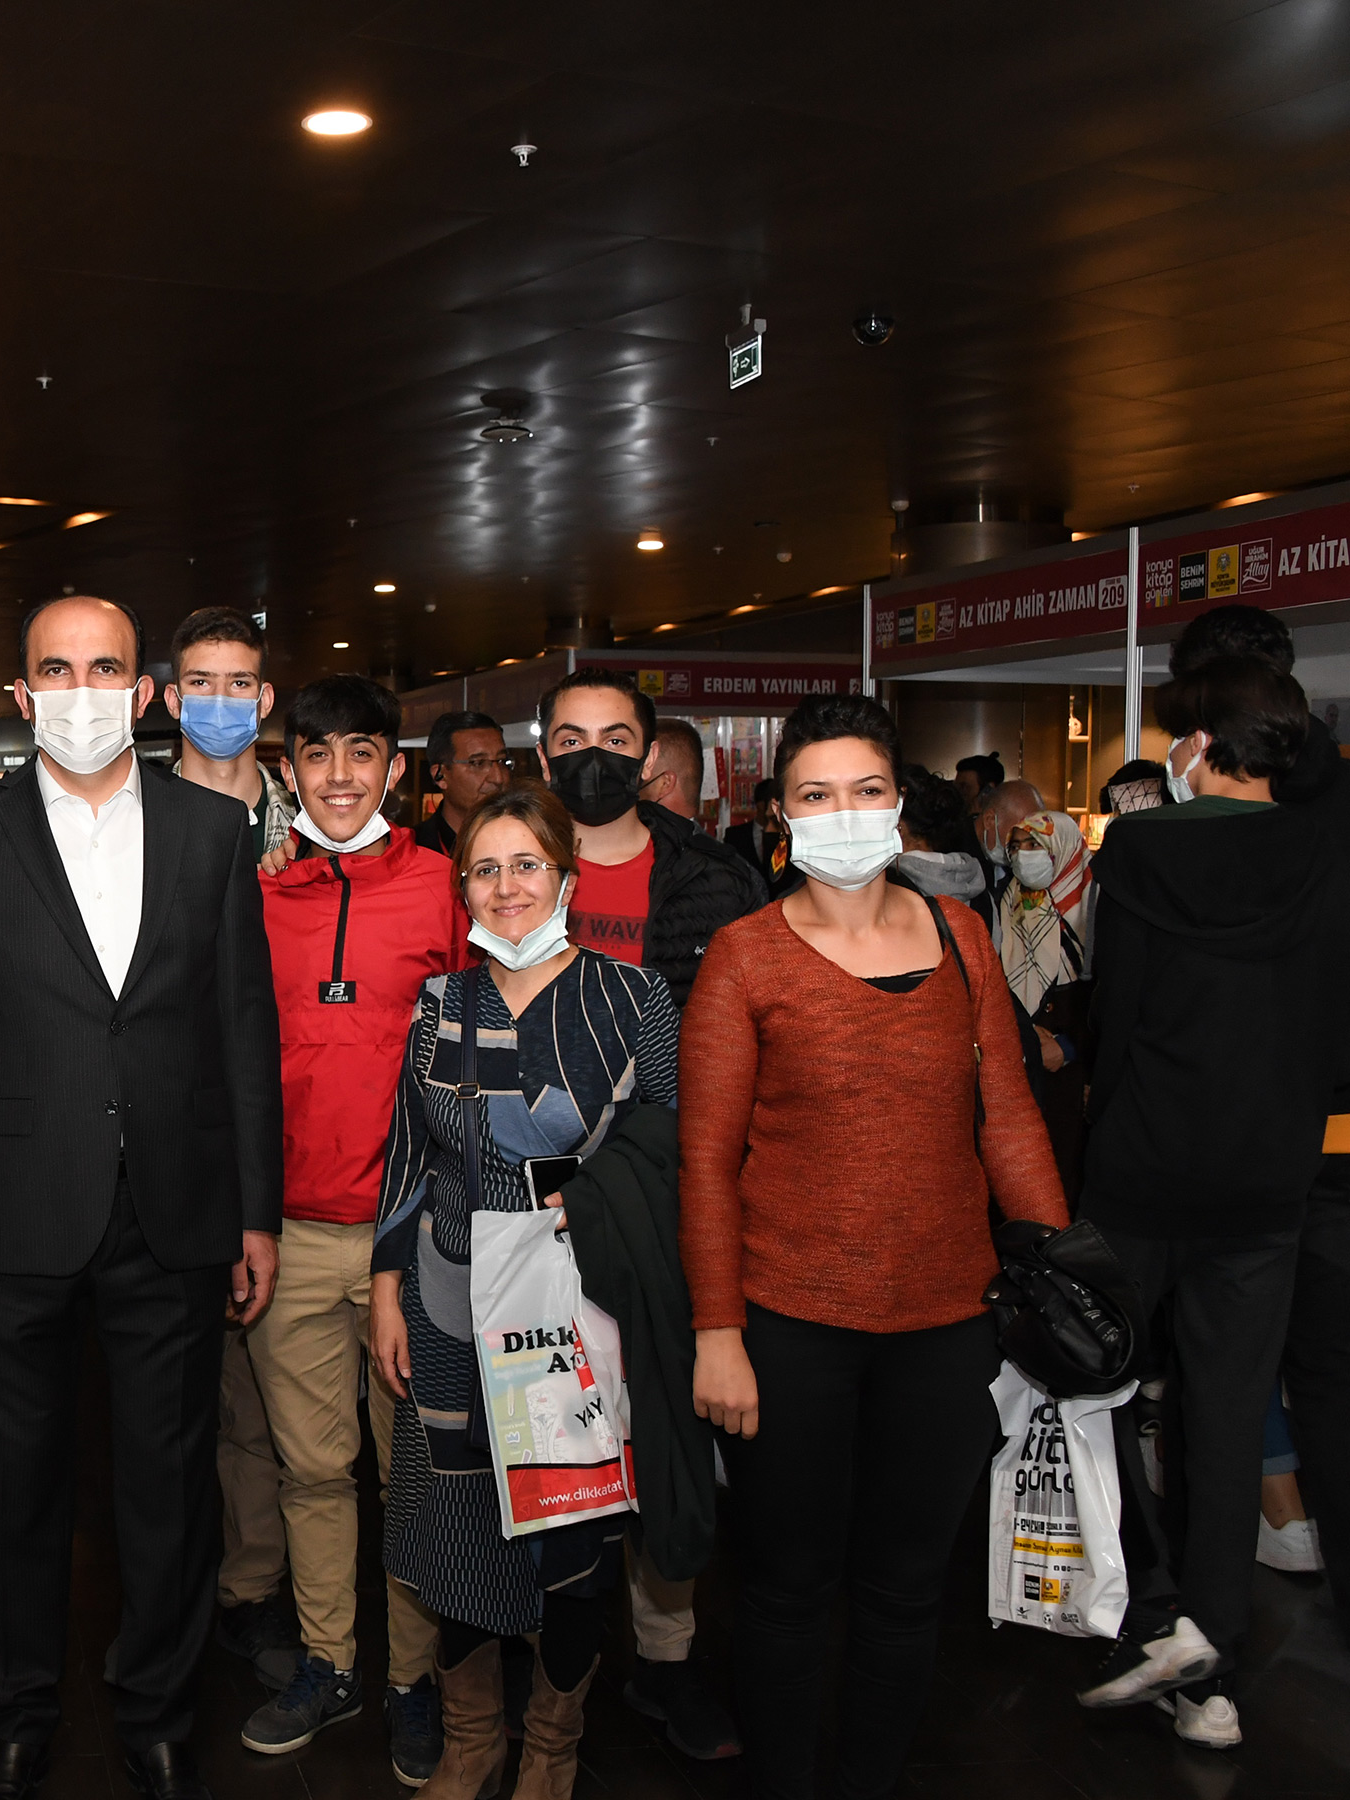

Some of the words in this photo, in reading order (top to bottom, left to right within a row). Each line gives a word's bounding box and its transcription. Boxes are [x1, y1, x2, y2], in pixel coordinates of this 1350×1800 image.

[1277, 546, 1302, 577] AZ
[1307, 534, 1350, 572] KİTA
[1145, 558, 1174, 578] konya
[1145, 572, 1174, 591] kitap
[959, 605, 974, 629] AZ
[977, 597, 1011, 626] KİTAP
[1014, 588, 1045, 620] AHİR
[1048, 583, 1096, 615] ZAMAN
[1101, 584, 1125, 608] 209
[703, 677, 756, 693] ERDEM
[762, 678, 836, 694] YAYINLARI
[590, 918, 645, 939] WAV
